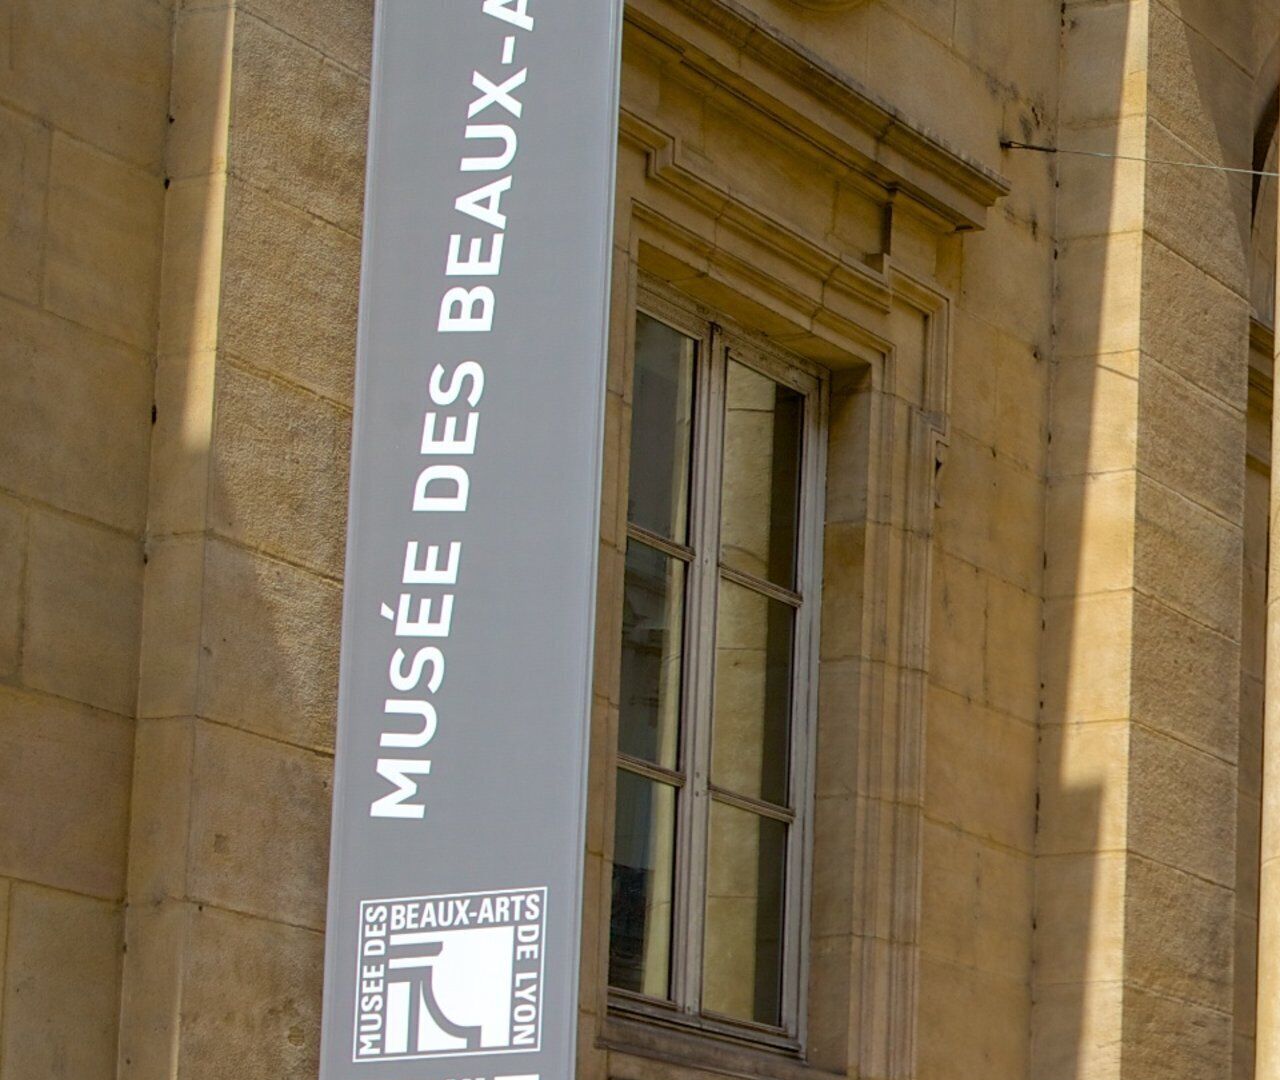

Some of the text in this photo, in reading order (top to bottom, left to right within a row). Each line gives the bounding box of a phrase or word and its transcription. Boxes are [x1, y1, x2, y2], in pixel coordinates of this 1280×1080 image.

[412, 361, 486, 513] DES
[370, 541, 462, 820] MUSÉE
[358, 905, 388, 1056] MUSEE DES
[390, 894, 540, 930] BEAUX-ARTS
[512, 925, 540, 1046] DE LYON
